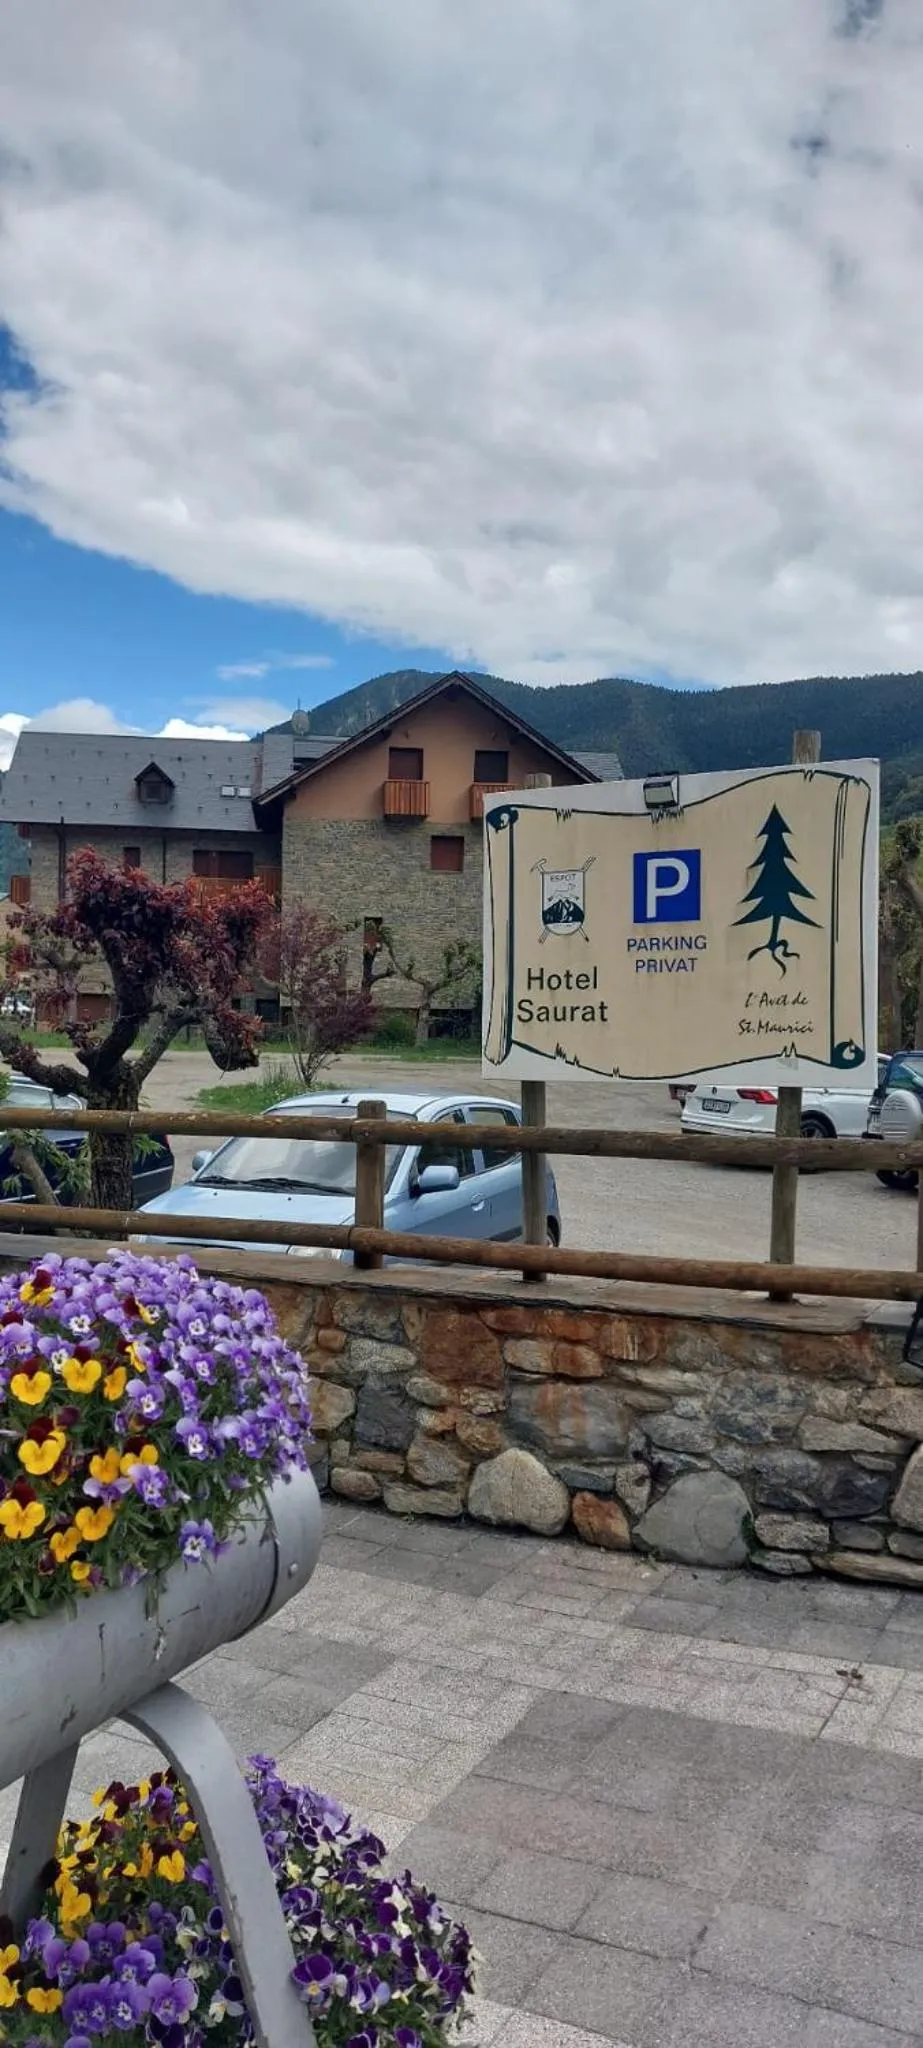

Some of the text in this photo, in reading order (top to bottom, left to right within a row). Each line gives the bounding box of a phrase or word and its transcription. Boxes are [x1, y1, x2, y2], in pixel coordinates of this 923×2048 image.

[645, 858, 691, 918] P
[627, 935, 707, 952] PARKING
[635, 958, 698, 973] PRIVAT
[527, 966, 598, 991] Hotel
[792, 991, 808, 1006] de
[517, 999, 609, 1022] Saurat
